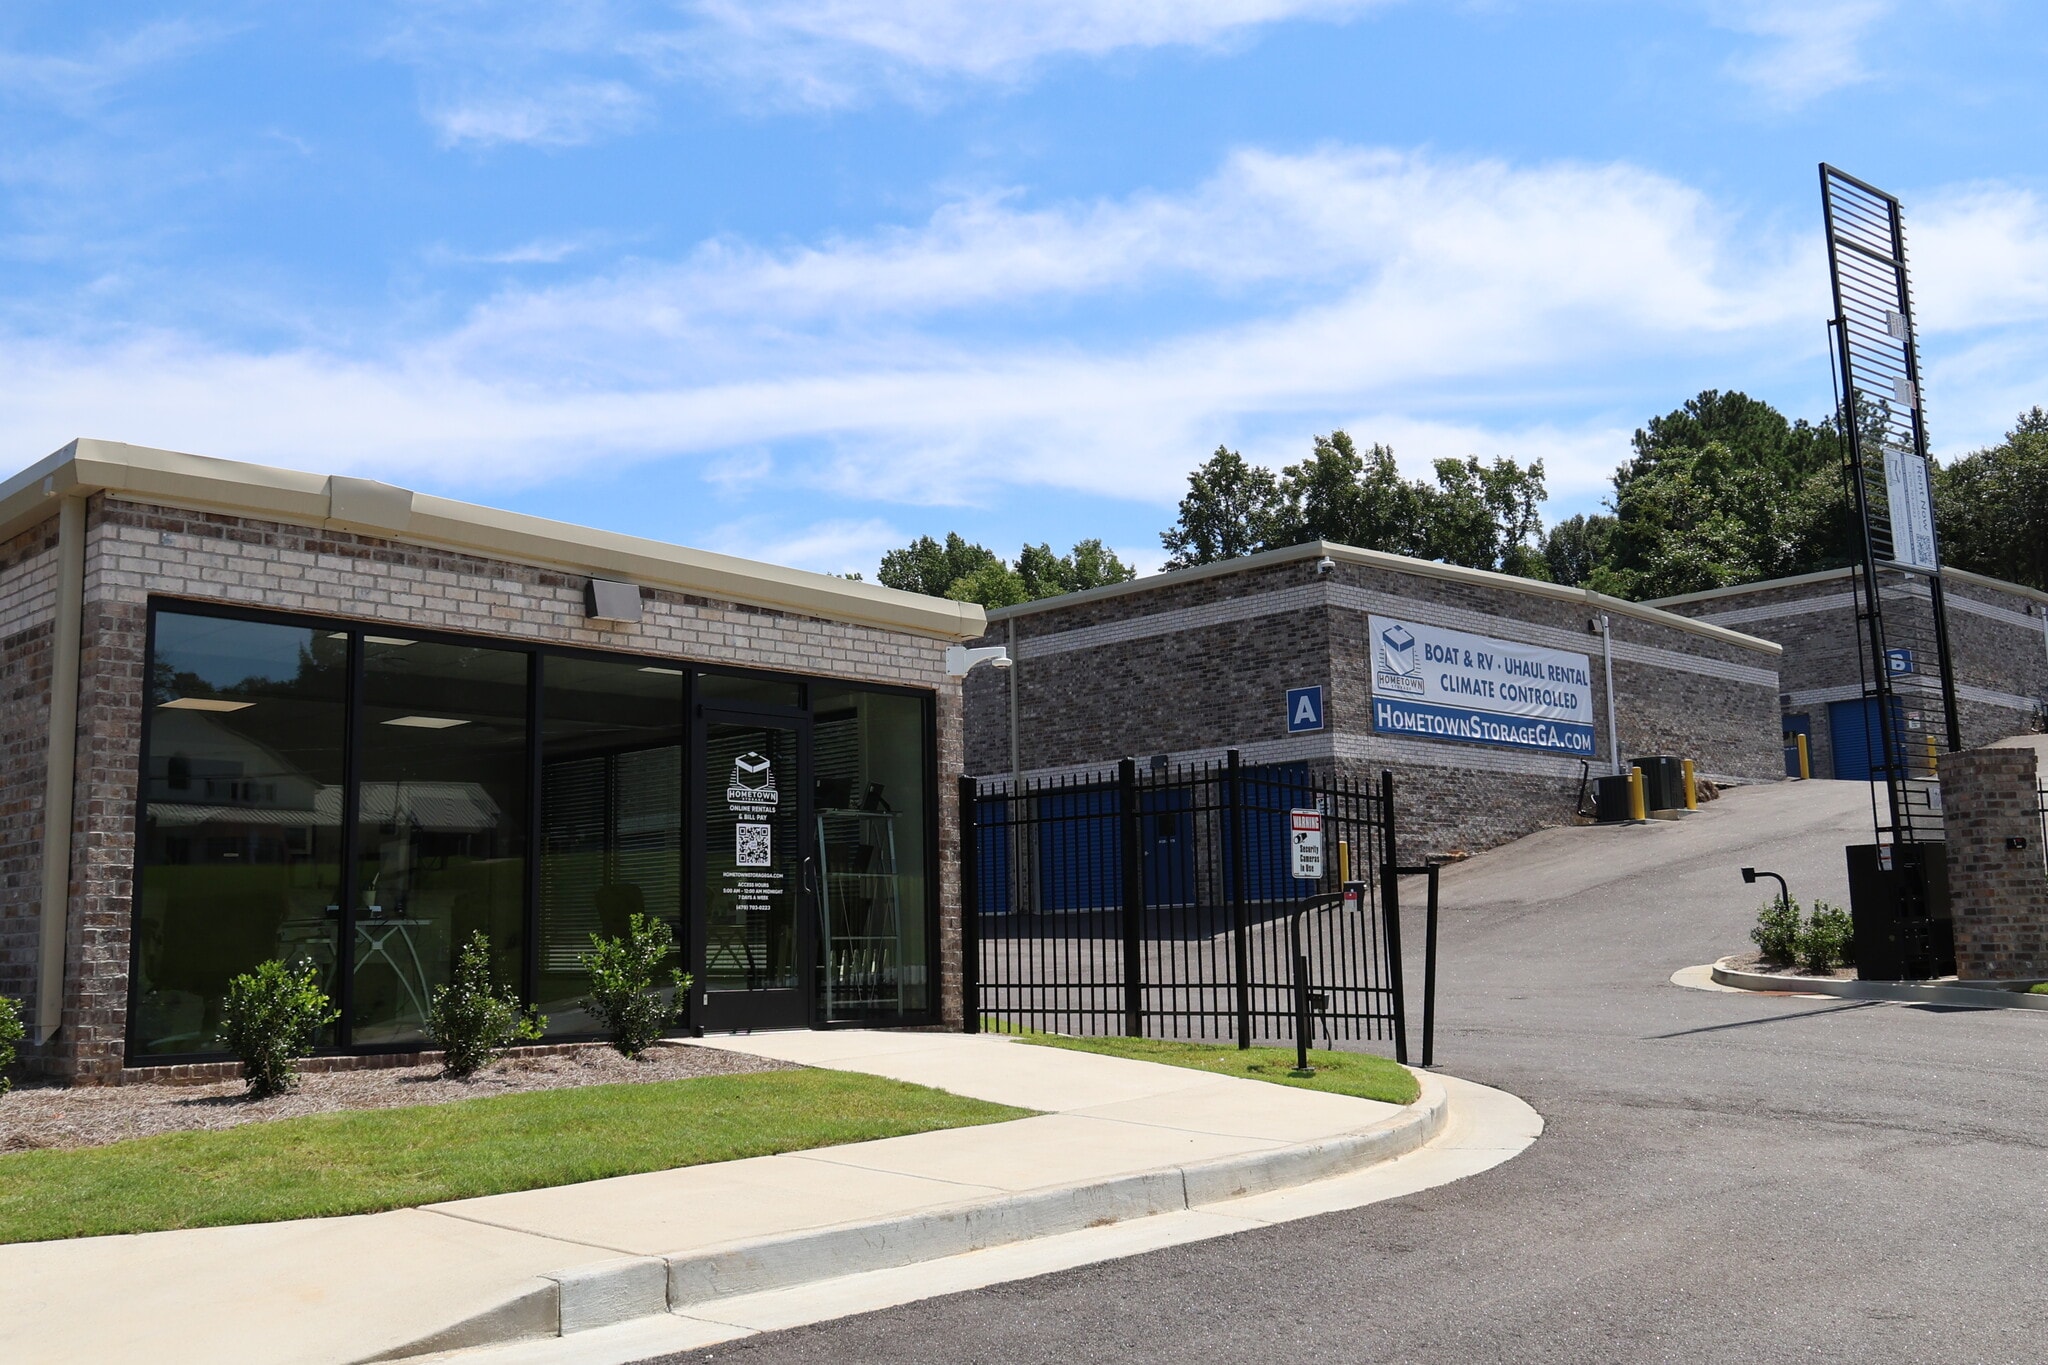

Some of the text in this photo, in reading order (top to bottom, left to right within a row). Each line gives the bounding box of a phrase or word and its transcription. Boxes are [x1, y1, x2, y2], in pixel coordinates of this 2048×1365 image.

[1916, 465, 1928, 531] Rent Now
[1425, 643, 1458, 665] BOAT
[1464, 651, 1473, 667] &
[1478, 653, 1492, 670] RV
[1504, 657, 1544, 679] UHAUL
[1549, 664, 1588, 686] RENTAL
[1891, 654, 1905, 670] B
[1379, 674, 1422, 690] HOMETOWN
[1441, 674, 1578, 710] CLIMATE CONTROLLED
[1294, 695, 1317, 724] A
[729, 790, 775, 800] HOMETOWN
[1293, 815, 1319, 829] WARNING
[1300, 845, 1319, 854] Security
[1306, 864, 1314, 872] Use
